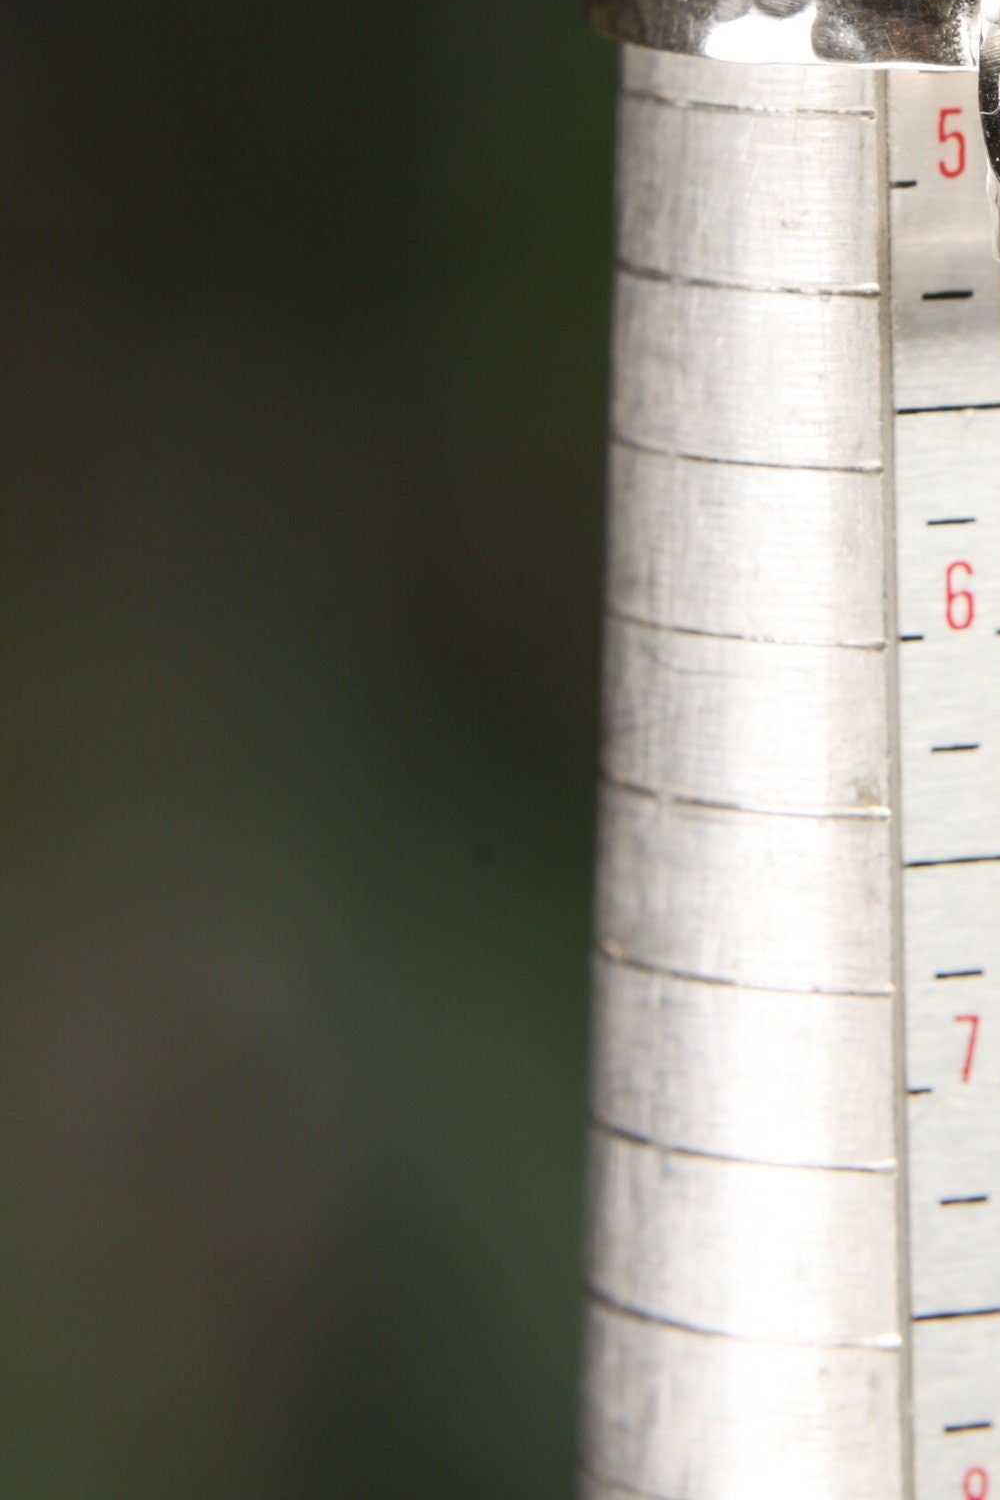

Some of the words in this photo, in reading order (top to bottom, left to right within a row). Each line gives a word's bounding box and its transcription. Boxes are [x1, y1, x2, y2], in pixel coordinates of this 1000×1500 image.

[936, 104, 967, 180] 5
[944, 559, 976, 632] 6
[953, 1013, 981, 1082] 7
